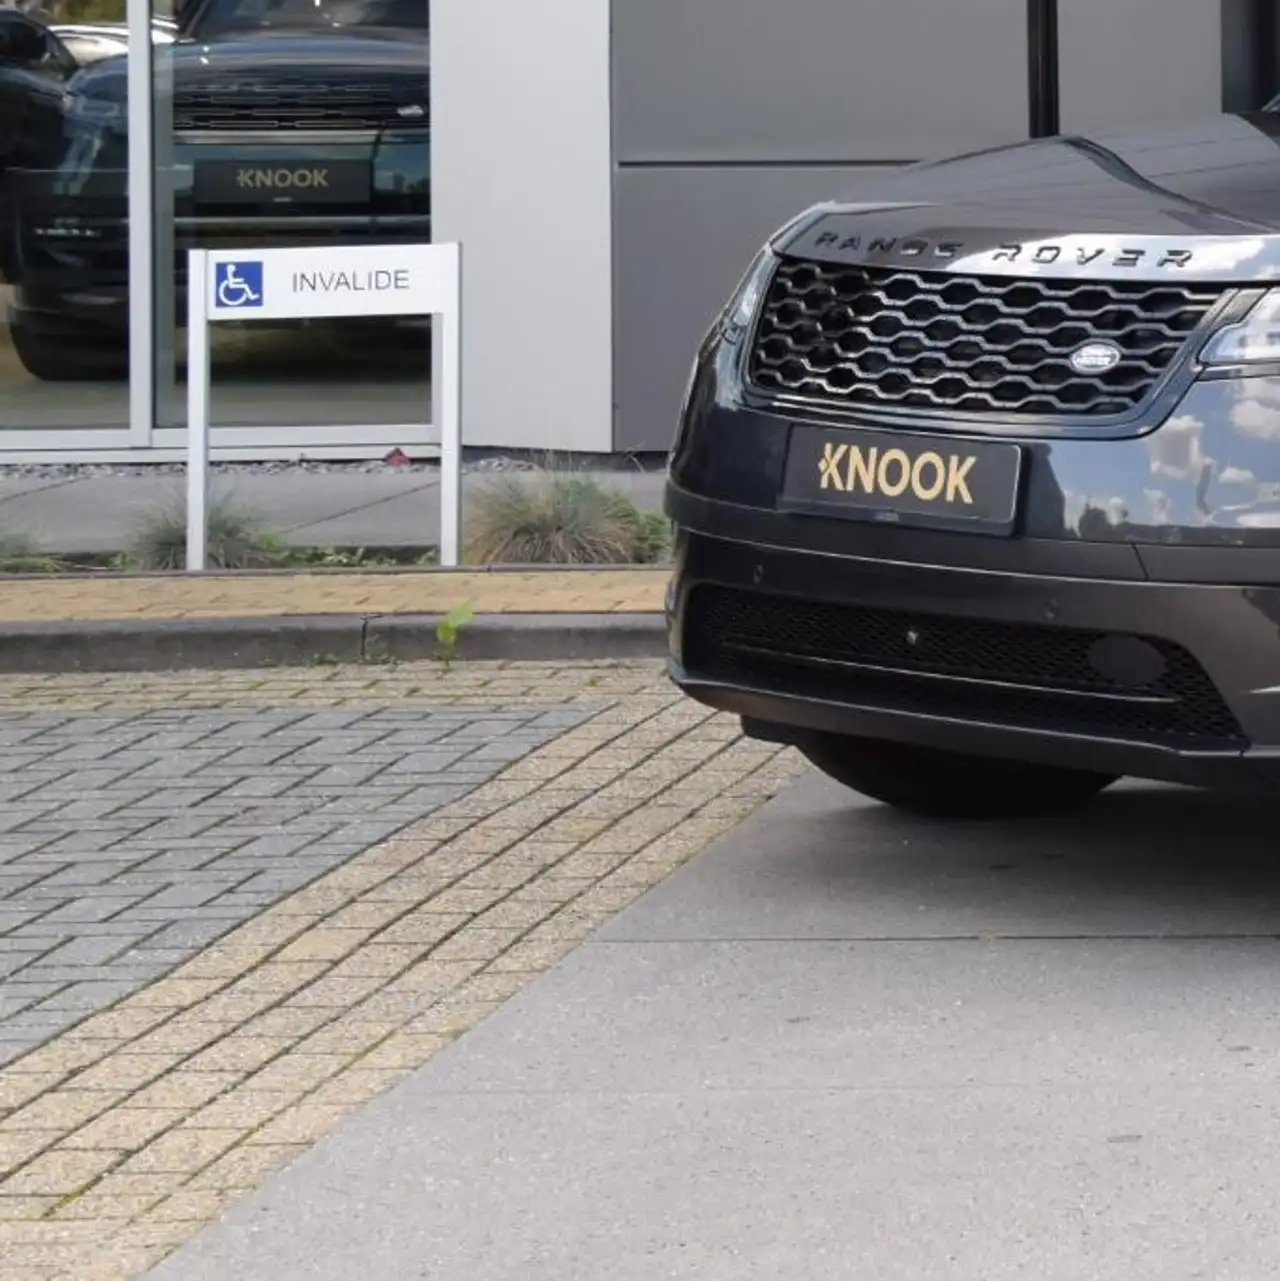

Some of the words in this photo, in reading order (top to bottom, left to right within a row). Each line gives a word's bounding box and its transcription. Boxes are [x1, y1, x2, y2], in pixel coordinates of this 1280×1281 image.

[236, 168, 329, 189] KNOOK
[814, 231, 963, 259] RANGE
[991, 243, 1194, 269] ROVER
[292, 268, 411, 293] INVALIDE
[818, 442, 977, 505] KNOOK
